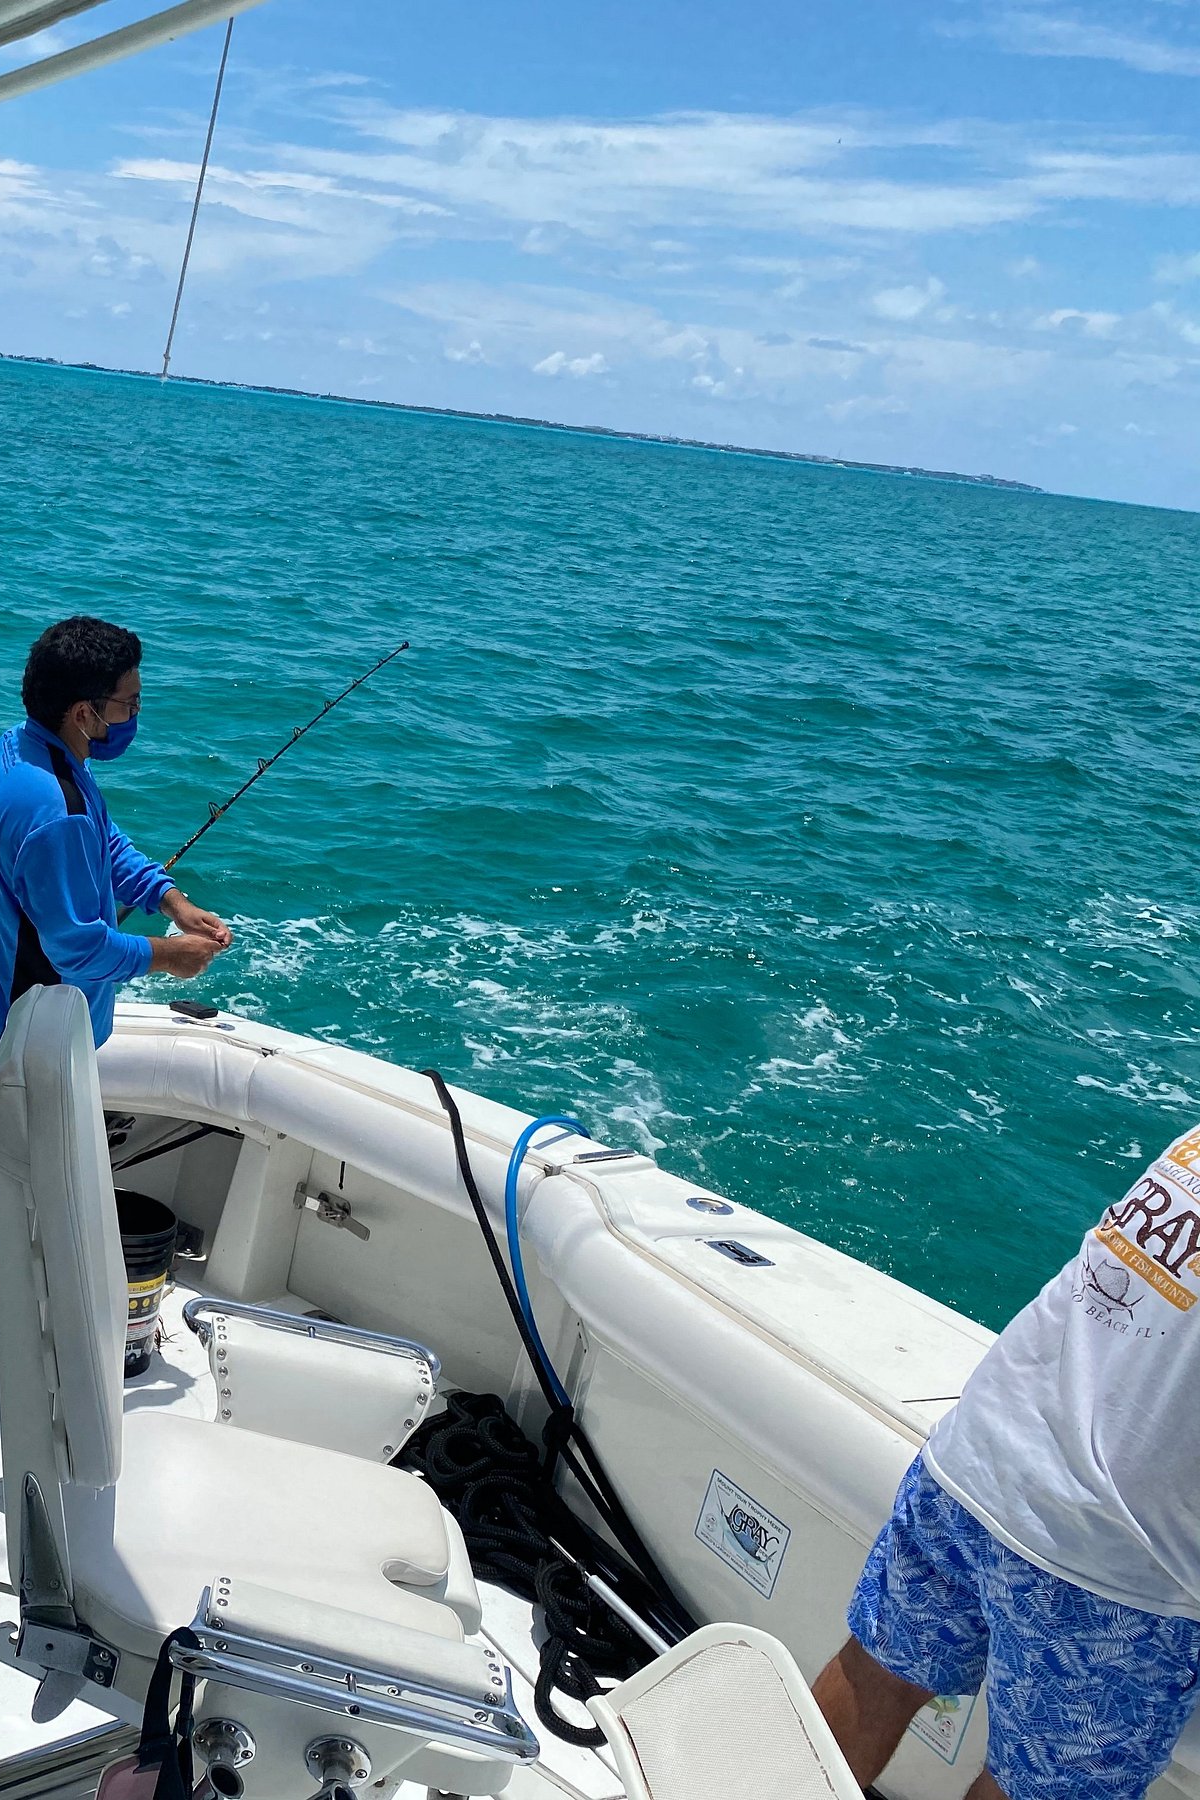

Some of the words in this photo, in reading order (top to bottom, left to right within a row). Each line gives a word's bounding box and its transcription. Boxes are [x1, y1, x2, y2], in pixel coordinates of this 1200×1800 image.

[1104, 1232, 1133, 1257] ROPHY
[1130, 1254, 1153, 1276] FISH
[1152, 1272, 1193, 1308] MOUNTS
[1135, 1327, 1152, 1338] FL
[732, 1508, 780, 1552] GRAY
